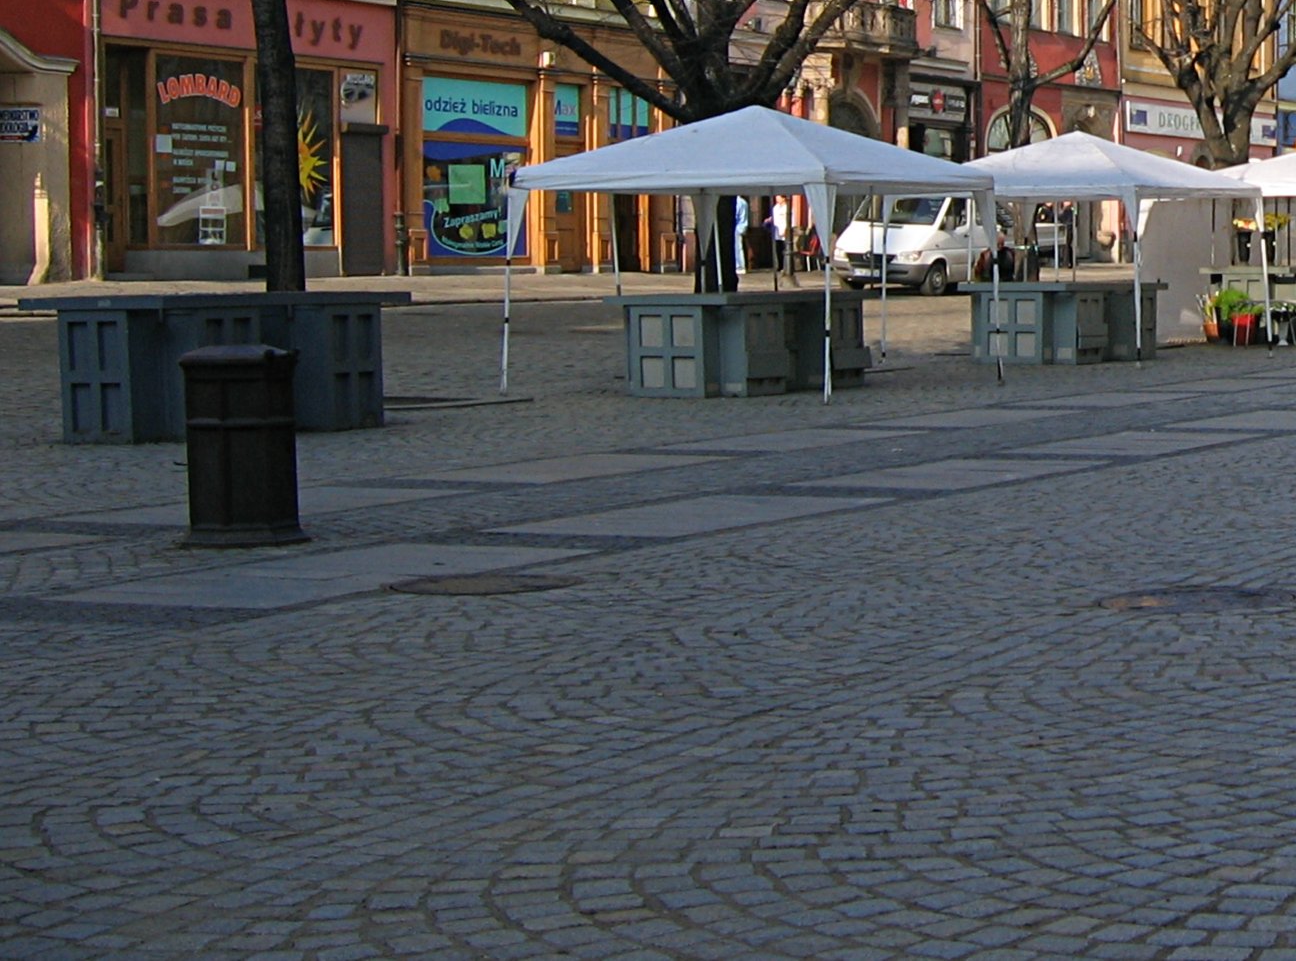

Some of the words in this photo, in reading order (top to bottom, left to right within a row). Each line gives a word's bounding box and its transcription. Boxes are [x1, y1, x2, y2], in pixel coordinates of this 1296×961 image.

[293, 10, 364, 51] łyty
[157, 73, 241, 108] LOMBARD
[425, 97, 467, 114] odzież
[472, 99, 518, 118] bielizna
